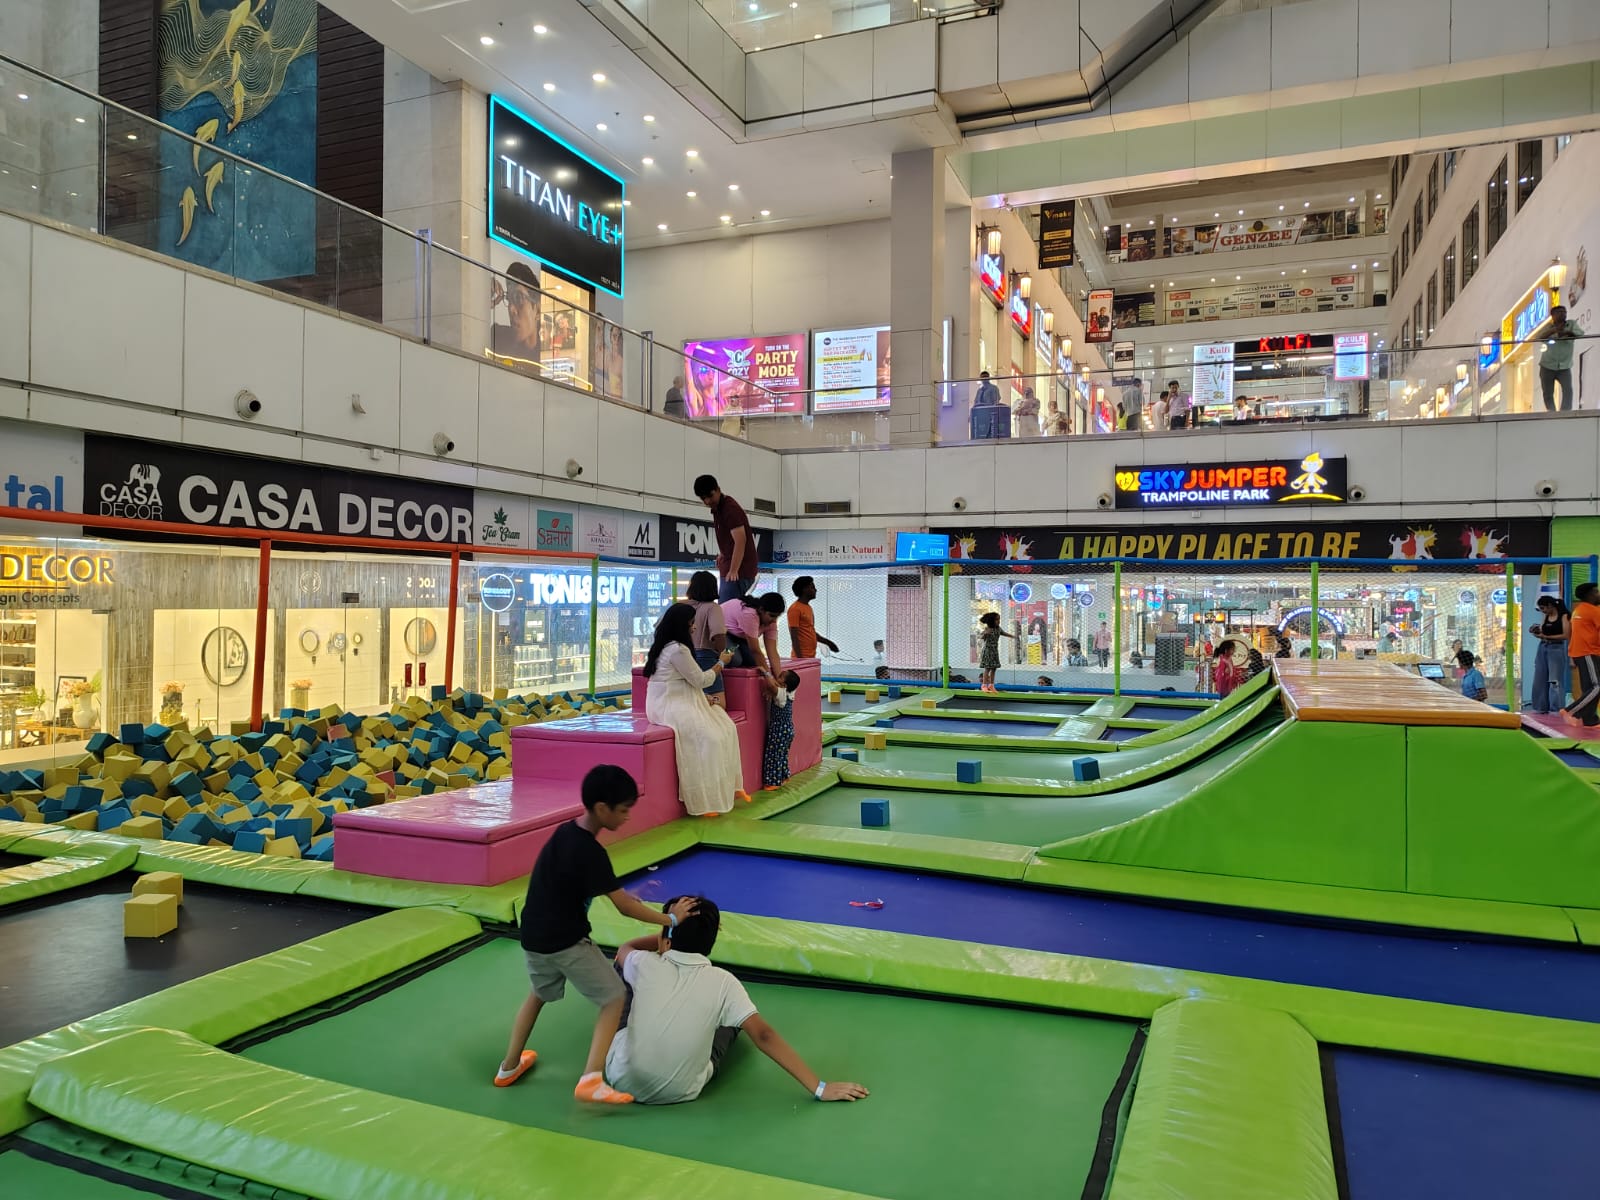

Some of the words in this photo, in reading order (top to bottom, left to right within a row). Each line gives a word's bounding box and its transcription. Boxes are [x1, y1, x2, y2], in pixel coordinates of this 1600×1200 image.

[500, 155, 571, 222] TITAN
[578, 201, 622, 246] EYE+
[1220, 229, 1293, 246] GENZEE
[1260, 292, 1277, 300] max
[755, 350, 799, 365] PARTY
[758, 364, 796, 378] MODE
[100, 484, 162, 502] CASA
[1142, 490, 1230, 503] TRAMPOLINE
[1233, 488, 1270, 501] PARK
[99, 501, 163, 521] DECOR
[178, 475, 323, 532] CASA
[339, 493, 474, 545] DECOR
[482, 524, 497, 542] Tea
[829, 546, 840, 554] Be
[842, 546, 849, 554] U
[851, 545, 884, 554] Natural
[1058, 536, 1075, 560] A
[1082, 535, 1174, 561] HAPPY
[1178, 533, 1270, 560] PLACE
[1278, 532, 1314, 558] TO
[1321, 532, 1361, 559] BE
[0, 553, 114, 584] DECOR
[530, 573, 635, 605] TONI&GUY
[21, 591, 80, 606] Concepts
